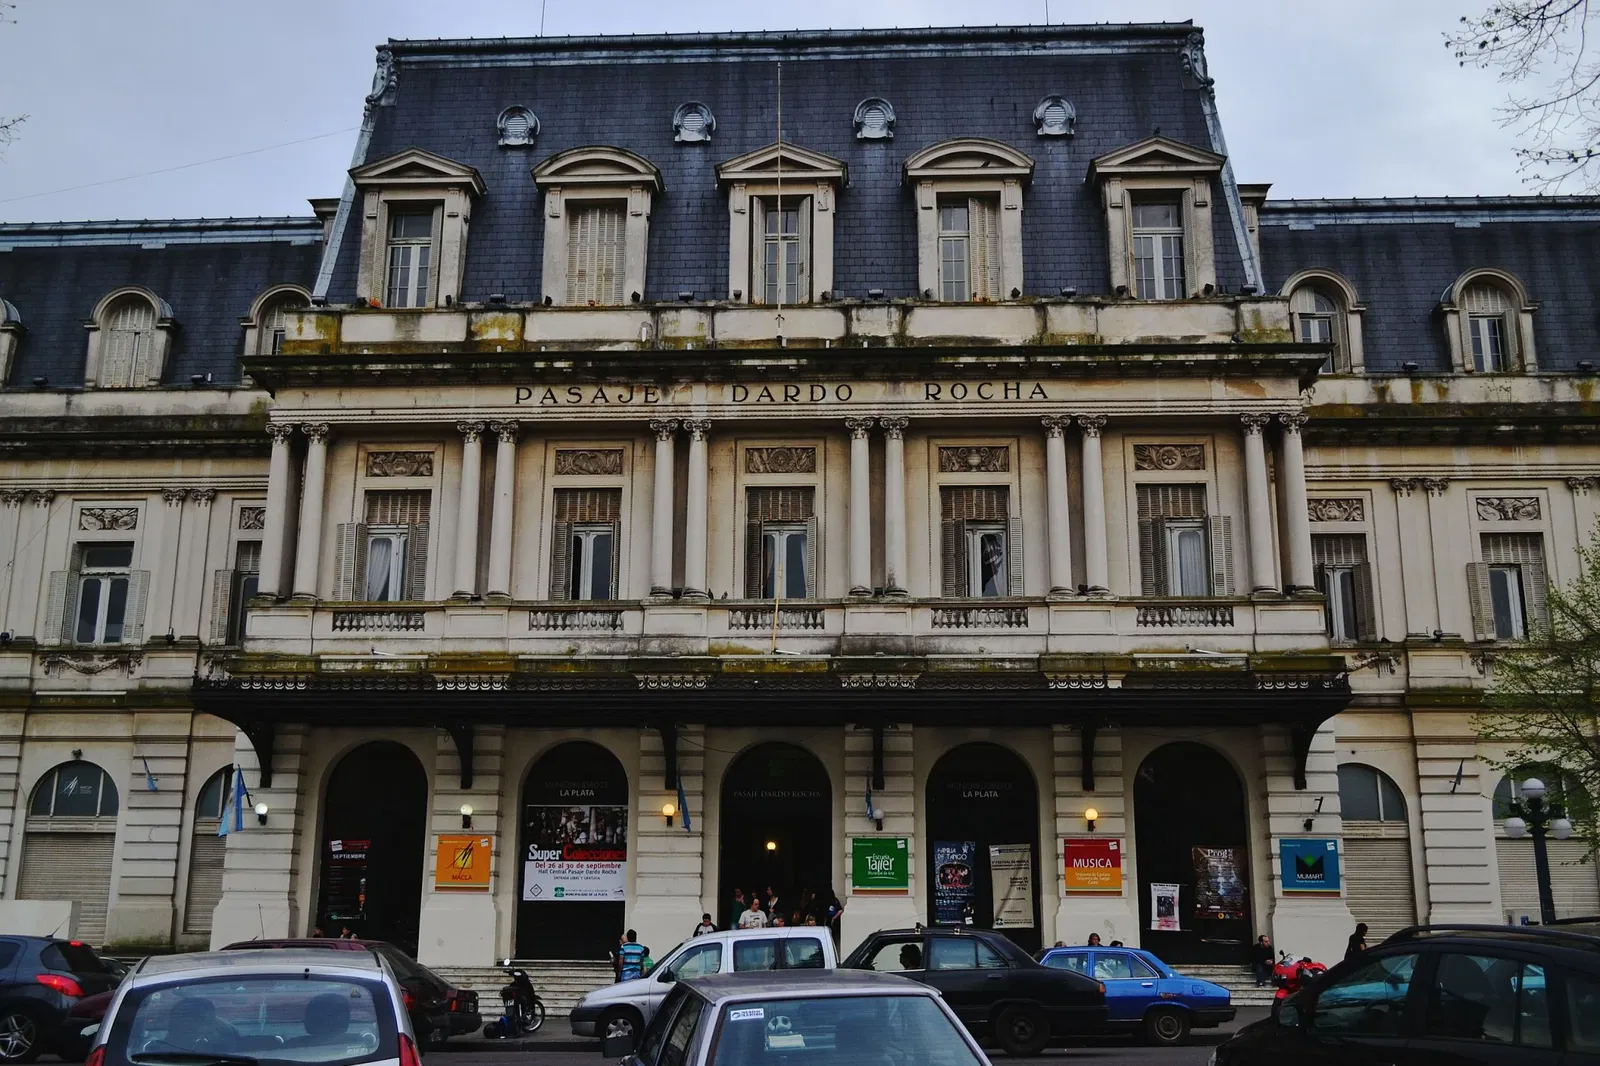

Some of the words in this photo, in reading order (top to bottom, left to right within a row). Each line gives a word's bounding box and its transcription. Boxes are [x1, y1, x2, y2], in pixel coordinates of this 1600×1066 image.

[515, 386, 660, 404] PASAJE
[732, 384, 853, 402] DARDO
[924, 382, 1049, 400] ROCHA
[560, 789, 570, 797] LA
[571, 789, 595, 797] PLATA
[760, 790, 791, 798] DARDO
[792, 790, 821, 798] ROCHA
[963, 790, 973, 798] LA
[974, 790, 999, 798] PLATA
[528, 843, 562, 861] Super
[865, 856, 895, 872] Taller
[1073, 858, 1112, 868] MUSICA
